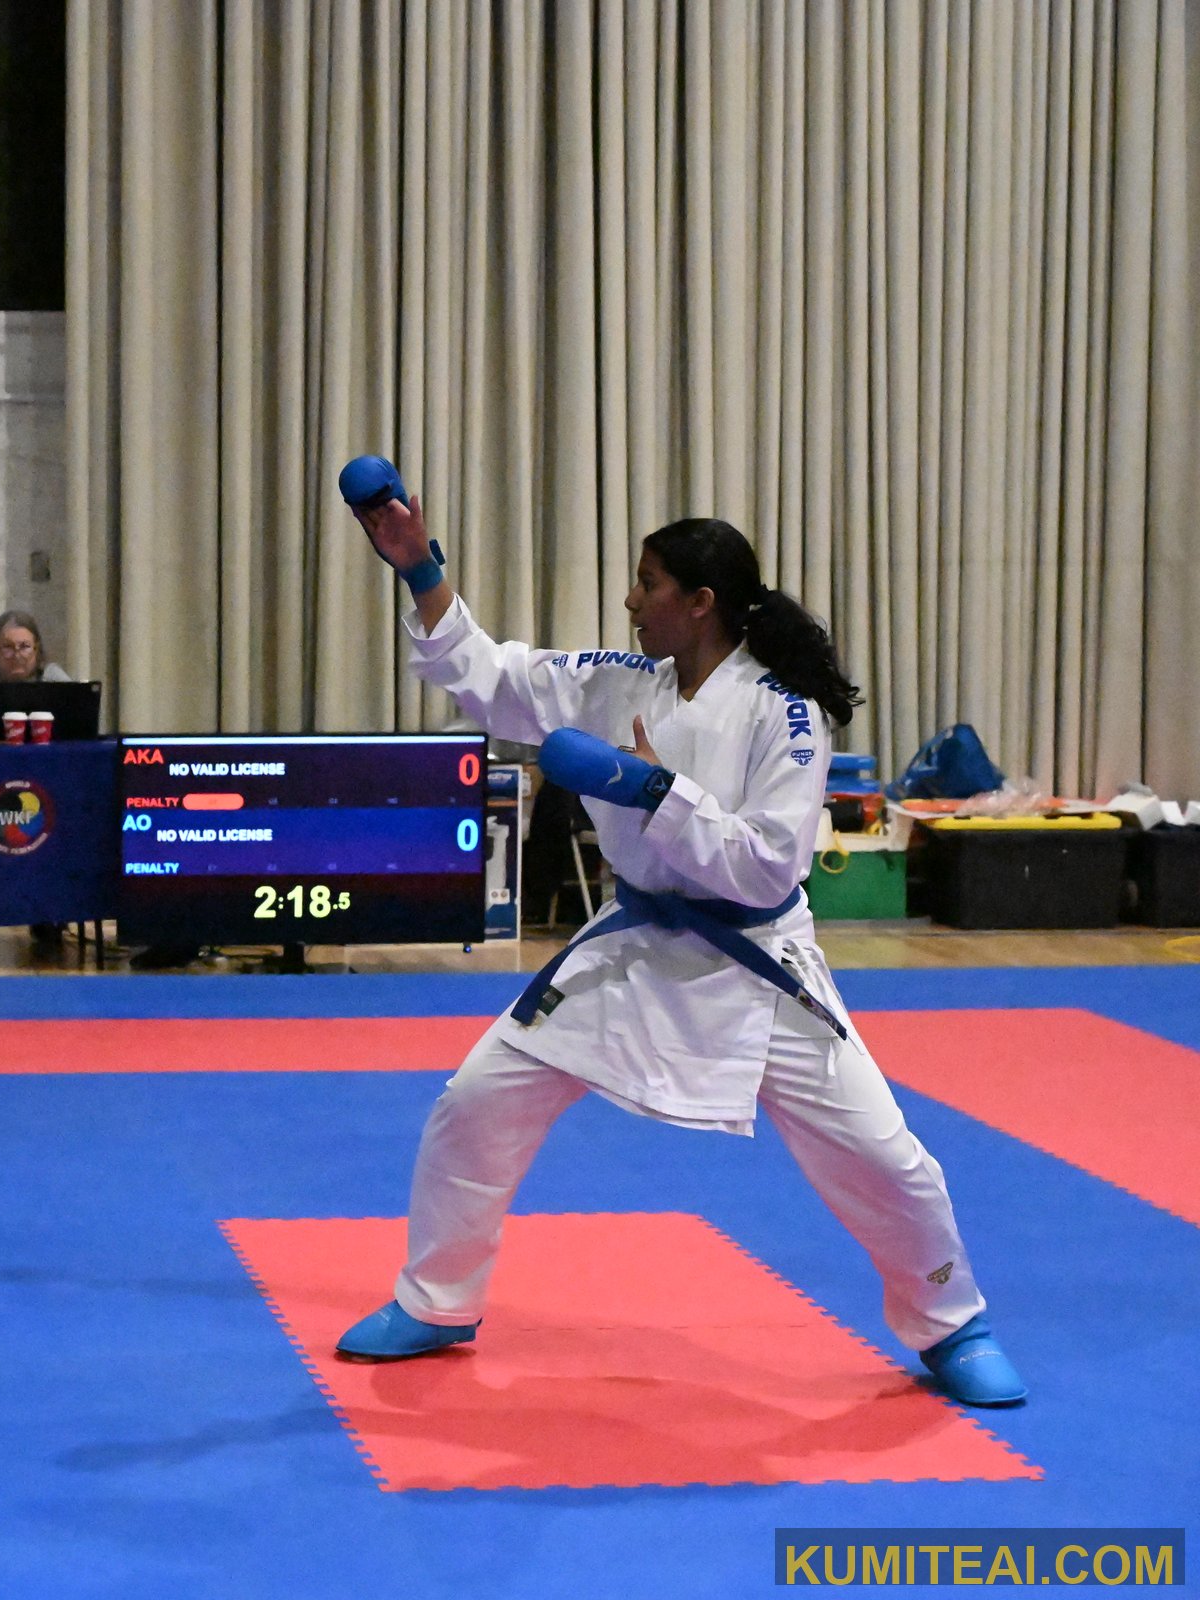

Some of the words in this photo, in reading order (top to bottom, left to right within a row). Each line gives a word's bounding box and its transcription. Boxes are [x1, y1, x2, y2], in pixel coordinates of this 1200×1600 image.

[577, 651, 658, 674] PUNOK
[123, 749, 164, 765] AKA
[169, 763, 189, 776] NO
[191, 763, 229, 776] VALID
[231, 763, 286, 776] LICENSE
[458, 753, 481, 786] 0
[126, 797, 179, 808] PENALTY
[0, 810, 34, 826] WKF
[122, 814, 152, 831] AO
[157, 829, 177, 842] NO
[179, 829, 216, 842] VALID
[218, 829, 273, 841] LICENSE
[456, 818, 479, 852] 0
[125, 862, 179, 874] PENALTY
[254, 885, 351, 919] 2:18.5
